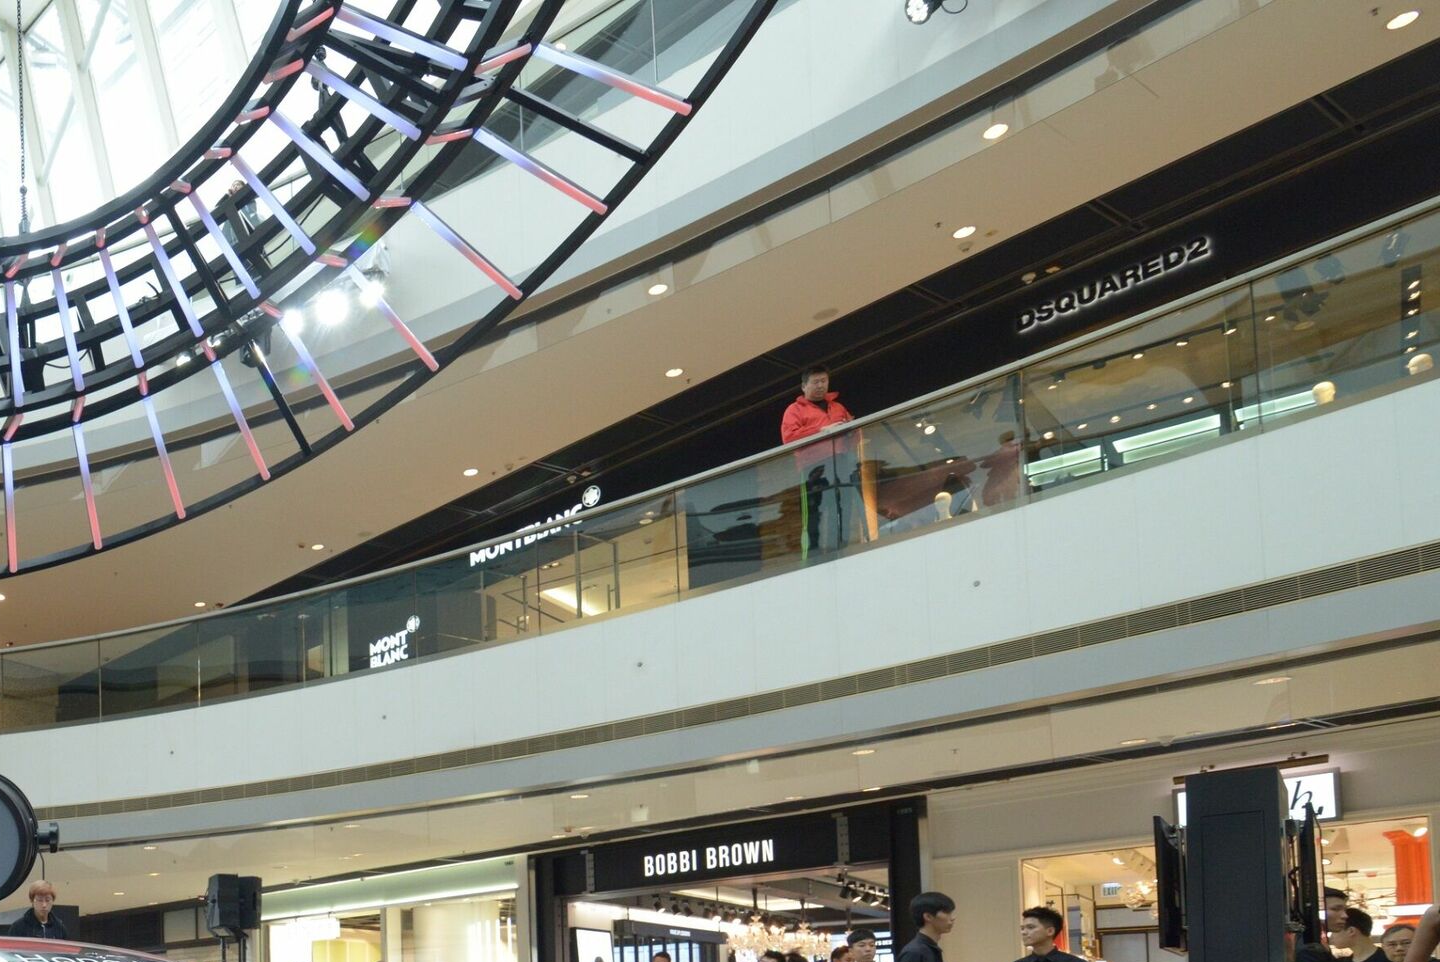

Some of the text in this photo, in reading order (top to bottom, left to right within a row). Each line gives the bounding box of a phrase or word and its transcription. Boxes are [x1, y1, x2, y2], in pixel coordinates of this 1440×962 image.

[1017, 236, 1211, 333] DSQUARED2
[369, 629, 408, 656] MONT
[370, 644, 408, 668] BLANC
[644, 839, 774, 877] BOBBI BROWN
